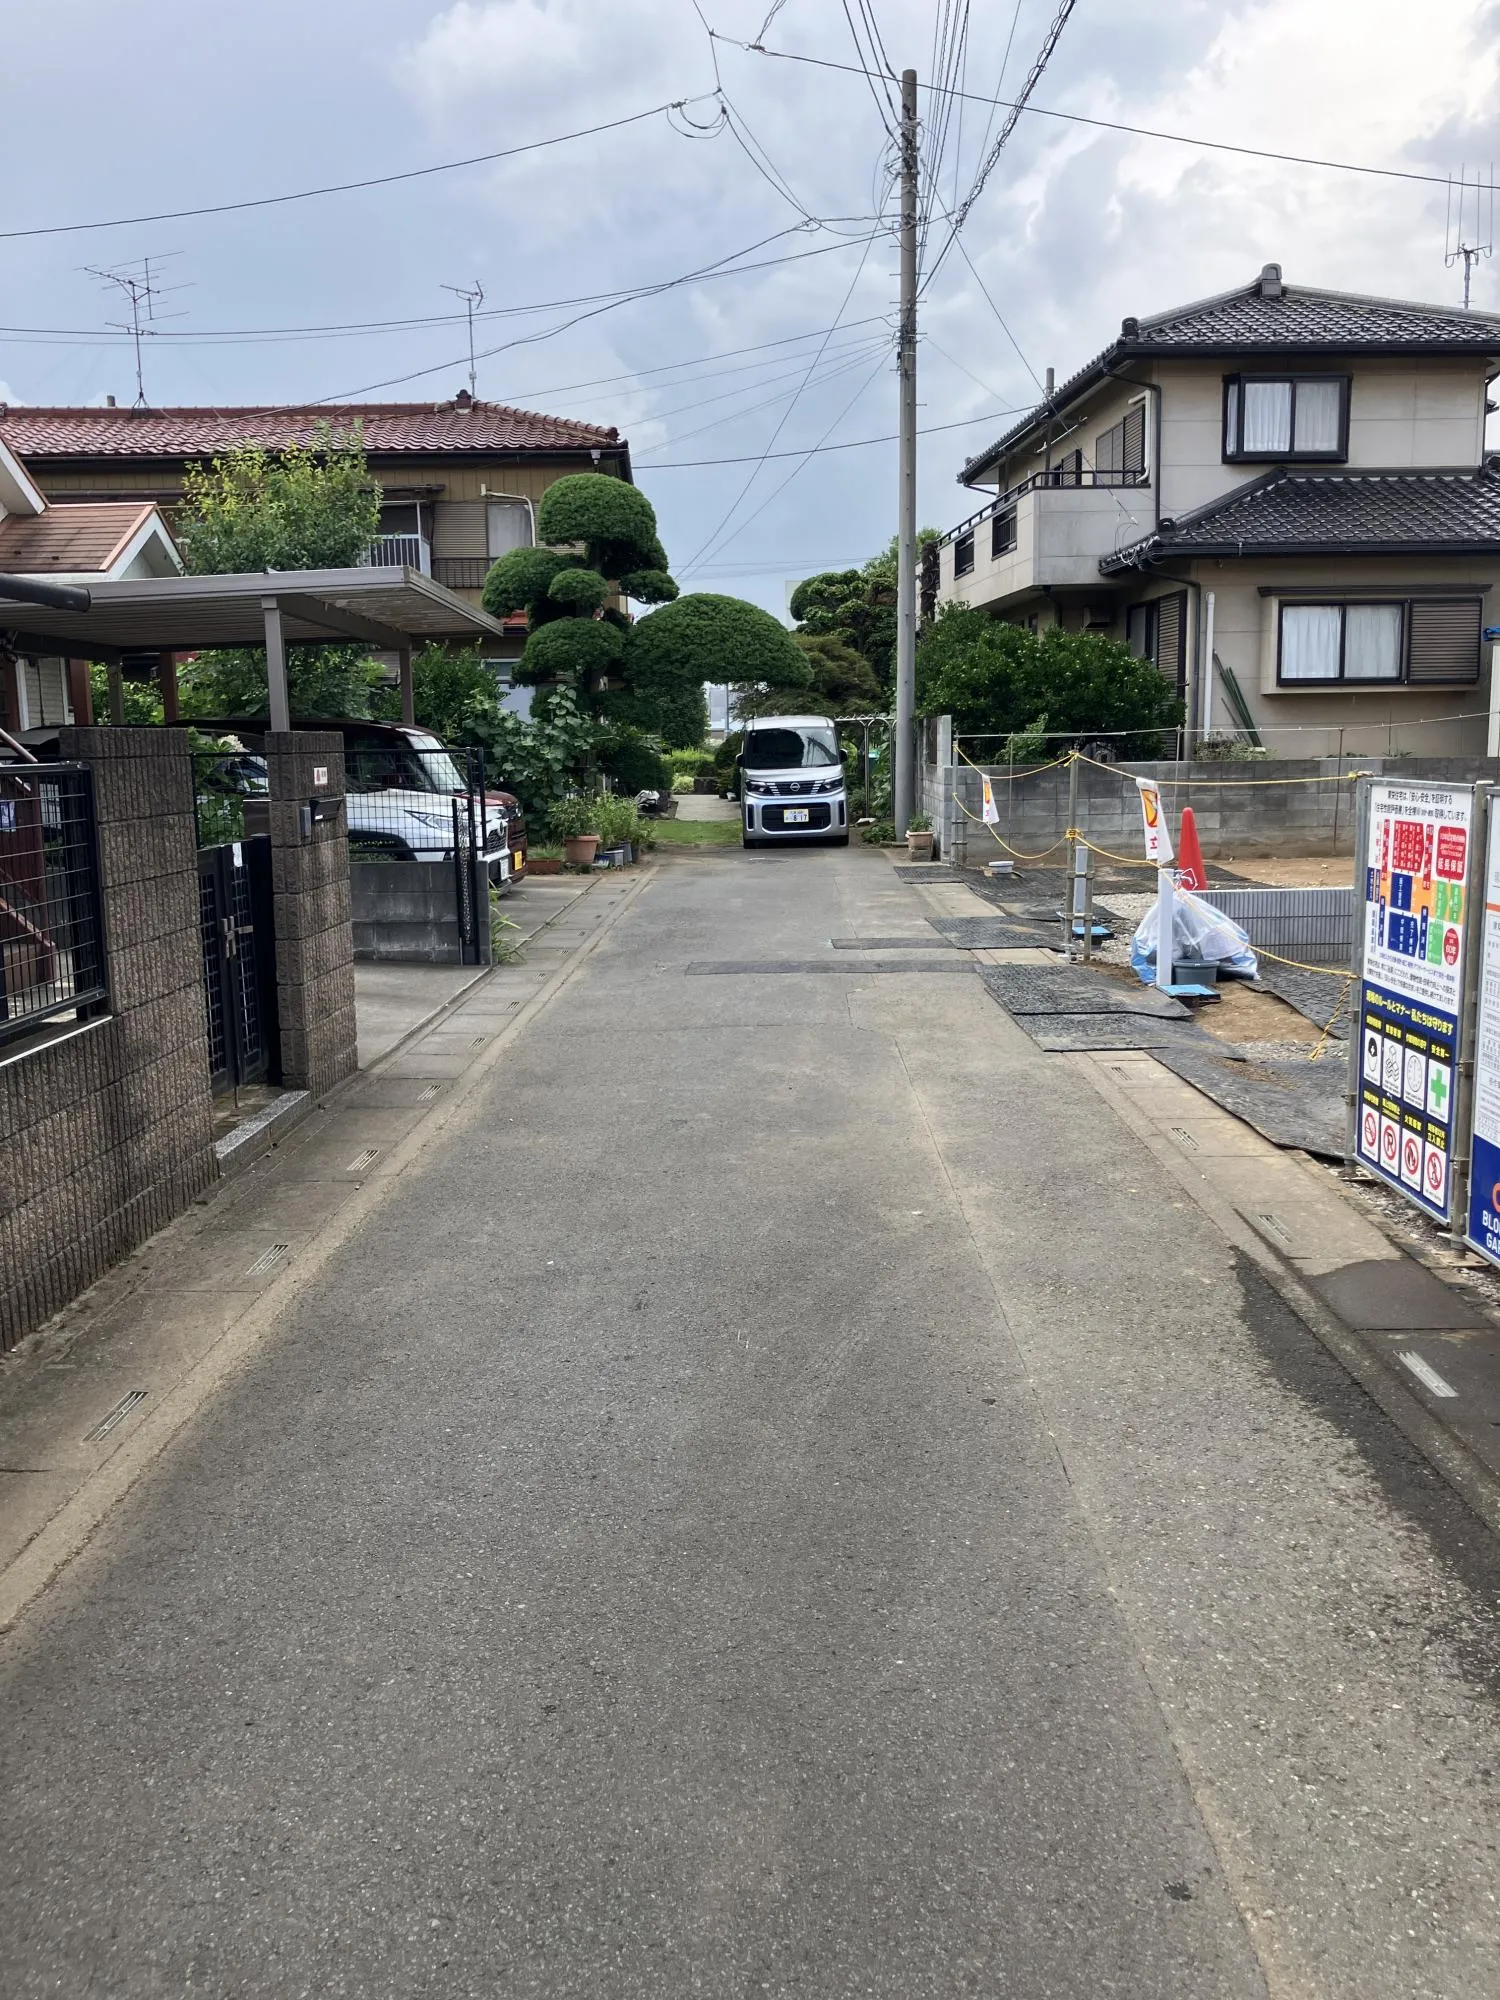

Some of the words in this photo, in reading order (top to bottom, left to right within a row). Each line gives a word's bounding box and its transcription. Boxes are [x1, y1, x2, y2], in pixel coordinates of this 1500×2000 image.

[1438, 858, 1463, 873] 延長保証
[1367, 990, 1410, 1015] のルールとマナー
